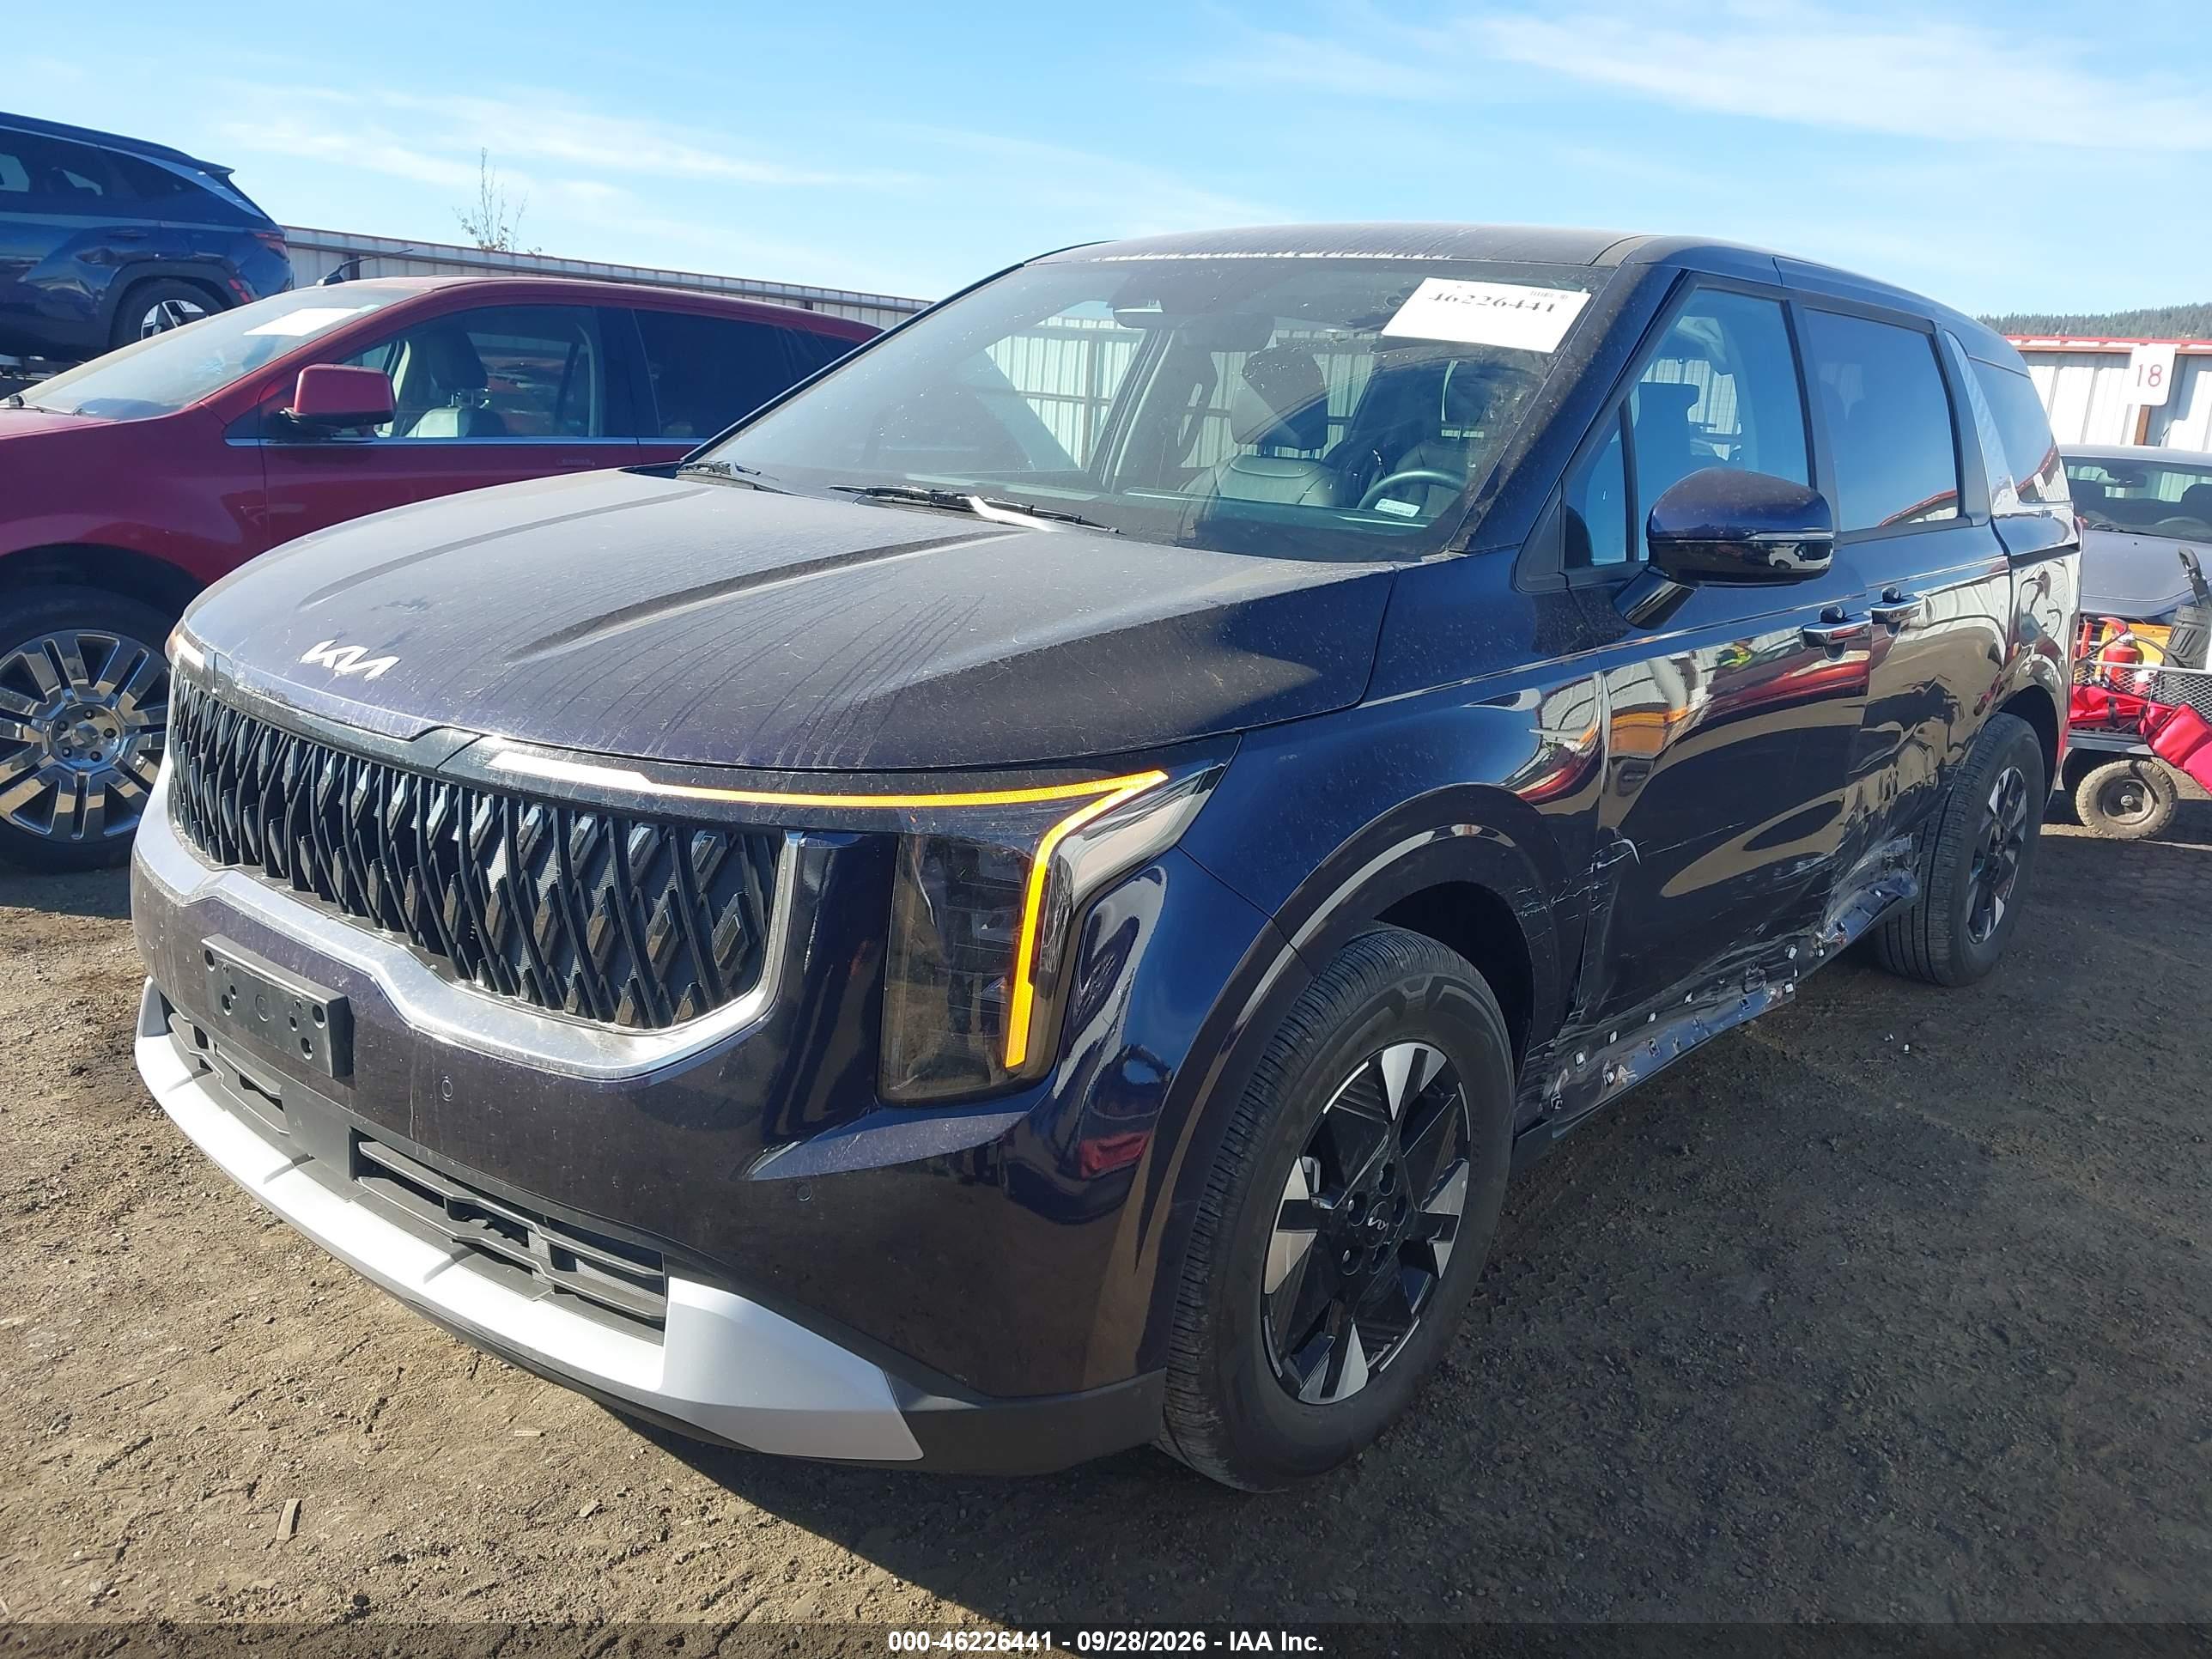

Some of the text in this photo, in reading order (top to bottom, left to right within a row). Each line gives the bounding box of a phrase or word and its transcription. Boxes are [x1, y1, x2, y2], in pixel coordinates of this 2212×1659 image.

[1428, 291, 1557, 313] 46226441
[2136, 363, 2163, 387] 18
[299, 639, 402, 681] KIA
